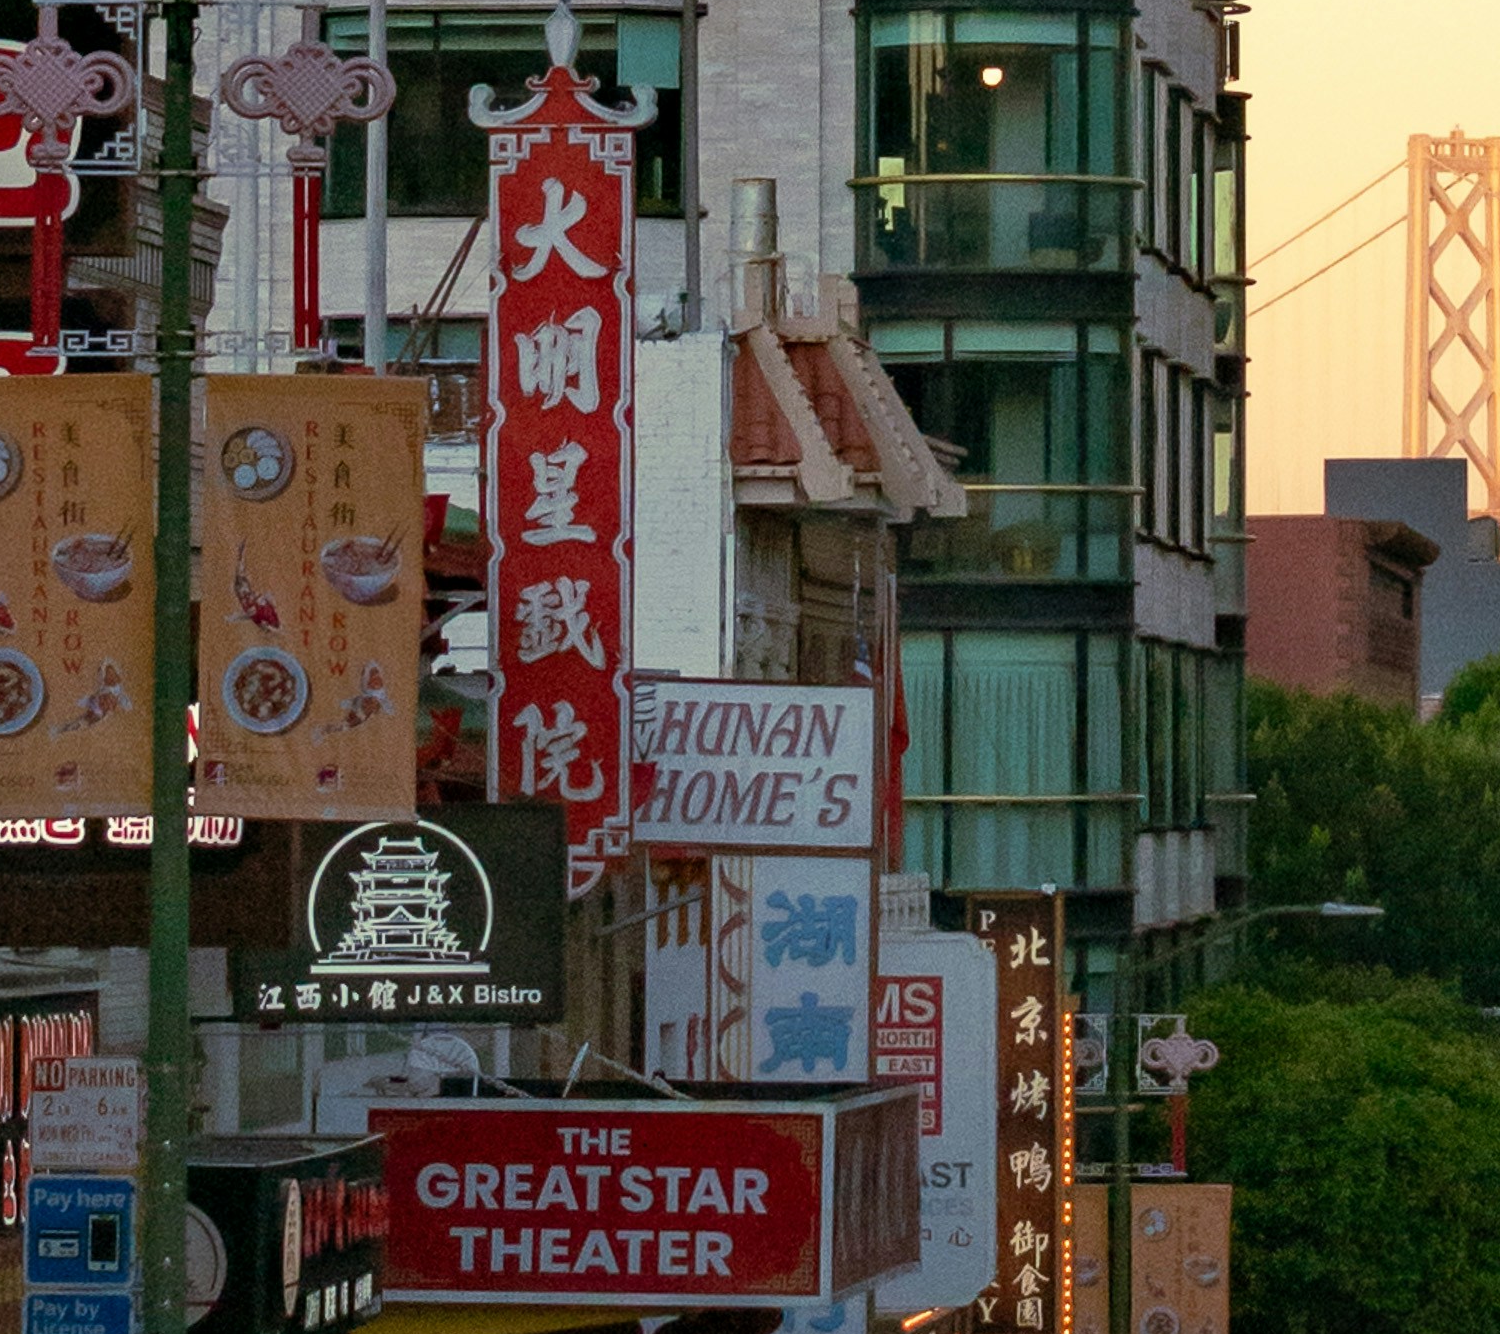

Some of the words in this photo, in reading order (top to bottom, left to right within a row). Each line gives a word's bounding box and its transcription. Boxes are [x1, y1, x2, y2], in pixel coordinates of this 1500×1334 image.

[63, 609, 83, 675] ROW
[329, 612, 348, 676] ROW
[653, 701, 846, 757] HUNAN
[637, 767, 858, 827] HOME'S
[257, 979, 400, 1011] 江西小館
[407, 985, 422, 1005] J
[426, 985, 444, 1005] &
[446, 985, 465, 1005] X
[474, 984, 542, 1006] Bistro
[759, 889, 858, 1073] 湖南
[35, 1060, 63, 1087] NO
[68, 1066, 136, 1088] PARKING
[889, 1058, 933, 1072] EAST
[98, 1097, 108, 1116] 6
[556, 1127, 631, 1156] THE
[33, 1188, 73, 1213] Pay
[77, 1188, 126, 1208] here
[414, 1163, 618, 1213] GREAT
[620, 1166, 769, 1216] STAR
[449, 1227, 734, 1276] THEATER
[32, 1299, 69, 1320] Pay
[74, 1299, 100, 1318] by
